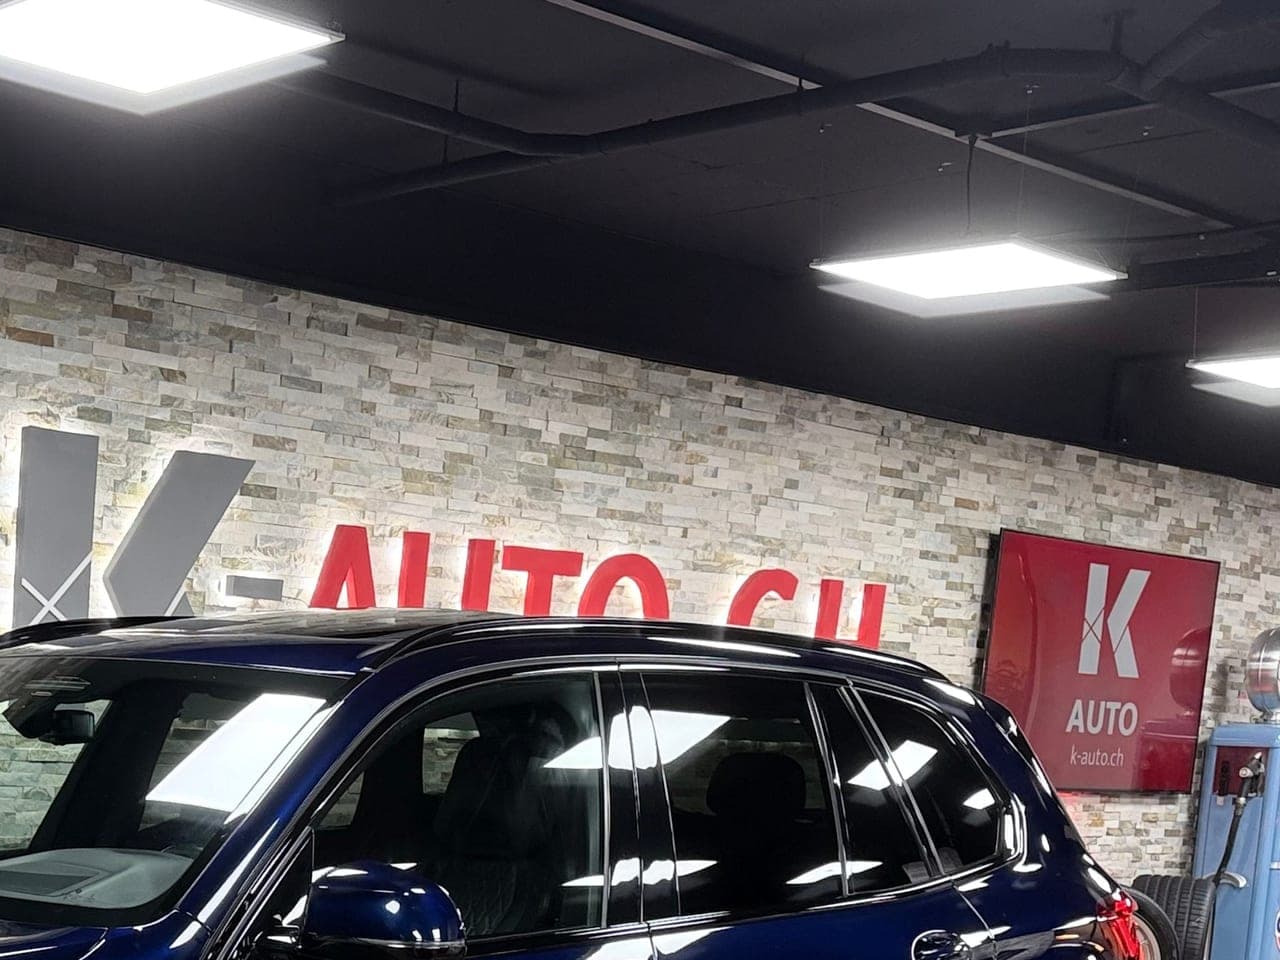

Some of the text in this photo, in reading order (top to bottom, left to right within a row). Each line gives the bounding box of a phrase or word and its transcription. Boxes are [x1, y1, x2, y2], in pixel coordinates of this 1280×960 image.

[1078, 563, 1151, 679] K
[1065, 699, 1138, 736] AUTO
[1070, 744, 1124, 767] k-auto.ch
